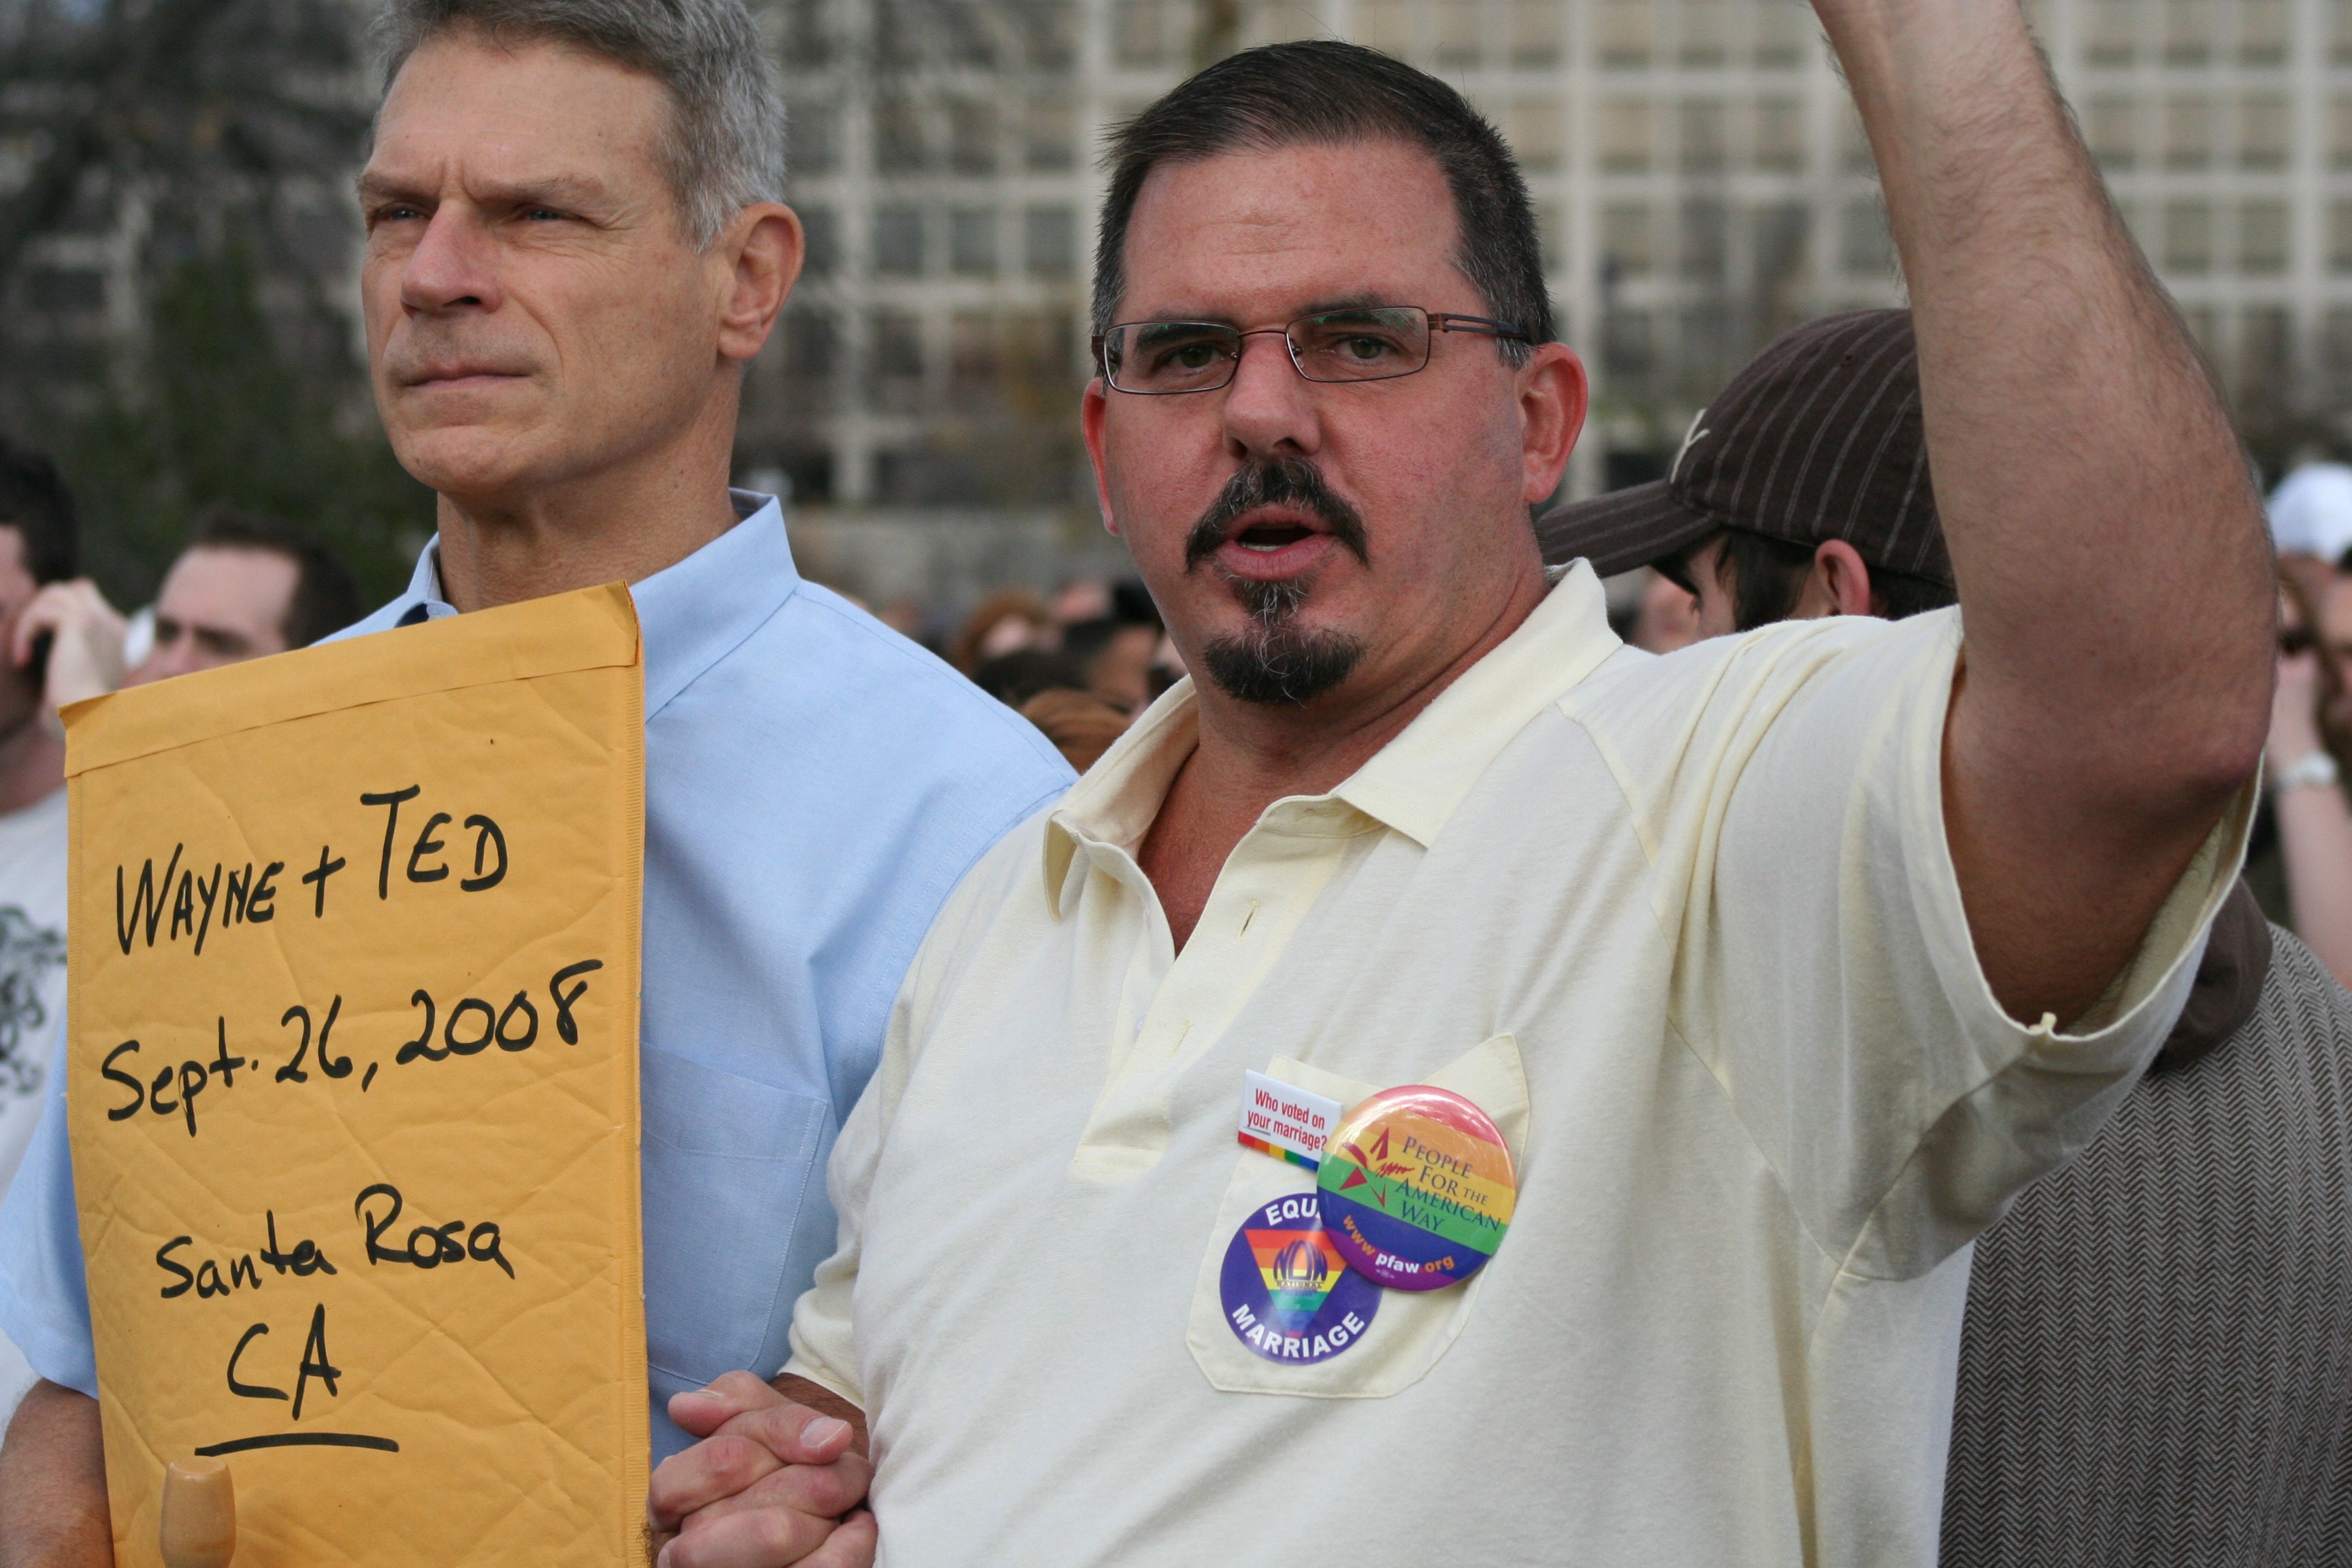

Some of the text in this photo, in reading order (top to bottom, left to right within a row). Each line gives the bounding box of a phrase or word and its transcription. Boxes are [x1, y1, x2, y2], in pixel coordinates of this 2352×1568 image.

[116, 784, 508, 956] WAYNE + TED
[101, 960, 604, 1137] Sept. 26, 2008
[1247, 1110, 1327, 1152] your marriage?
[1255, 1088, 1325, 1130] Who voted on
[1403, 1136, 1473, 1179] PEOPLE
[1394, 1177, 1501, 1232] AMERICAN
[1419, 1165, 1488, 1205] FOR THE
[1265, 1198, 1320, 1226] EQU
[1401, 1199, 1445, 1232] WAY
[156, 1183, 515, 1299] Santa Rosa
[1232, 1303, 1365, 1358] MARRIAGE
[226, 1303, 342, 1421] CA
